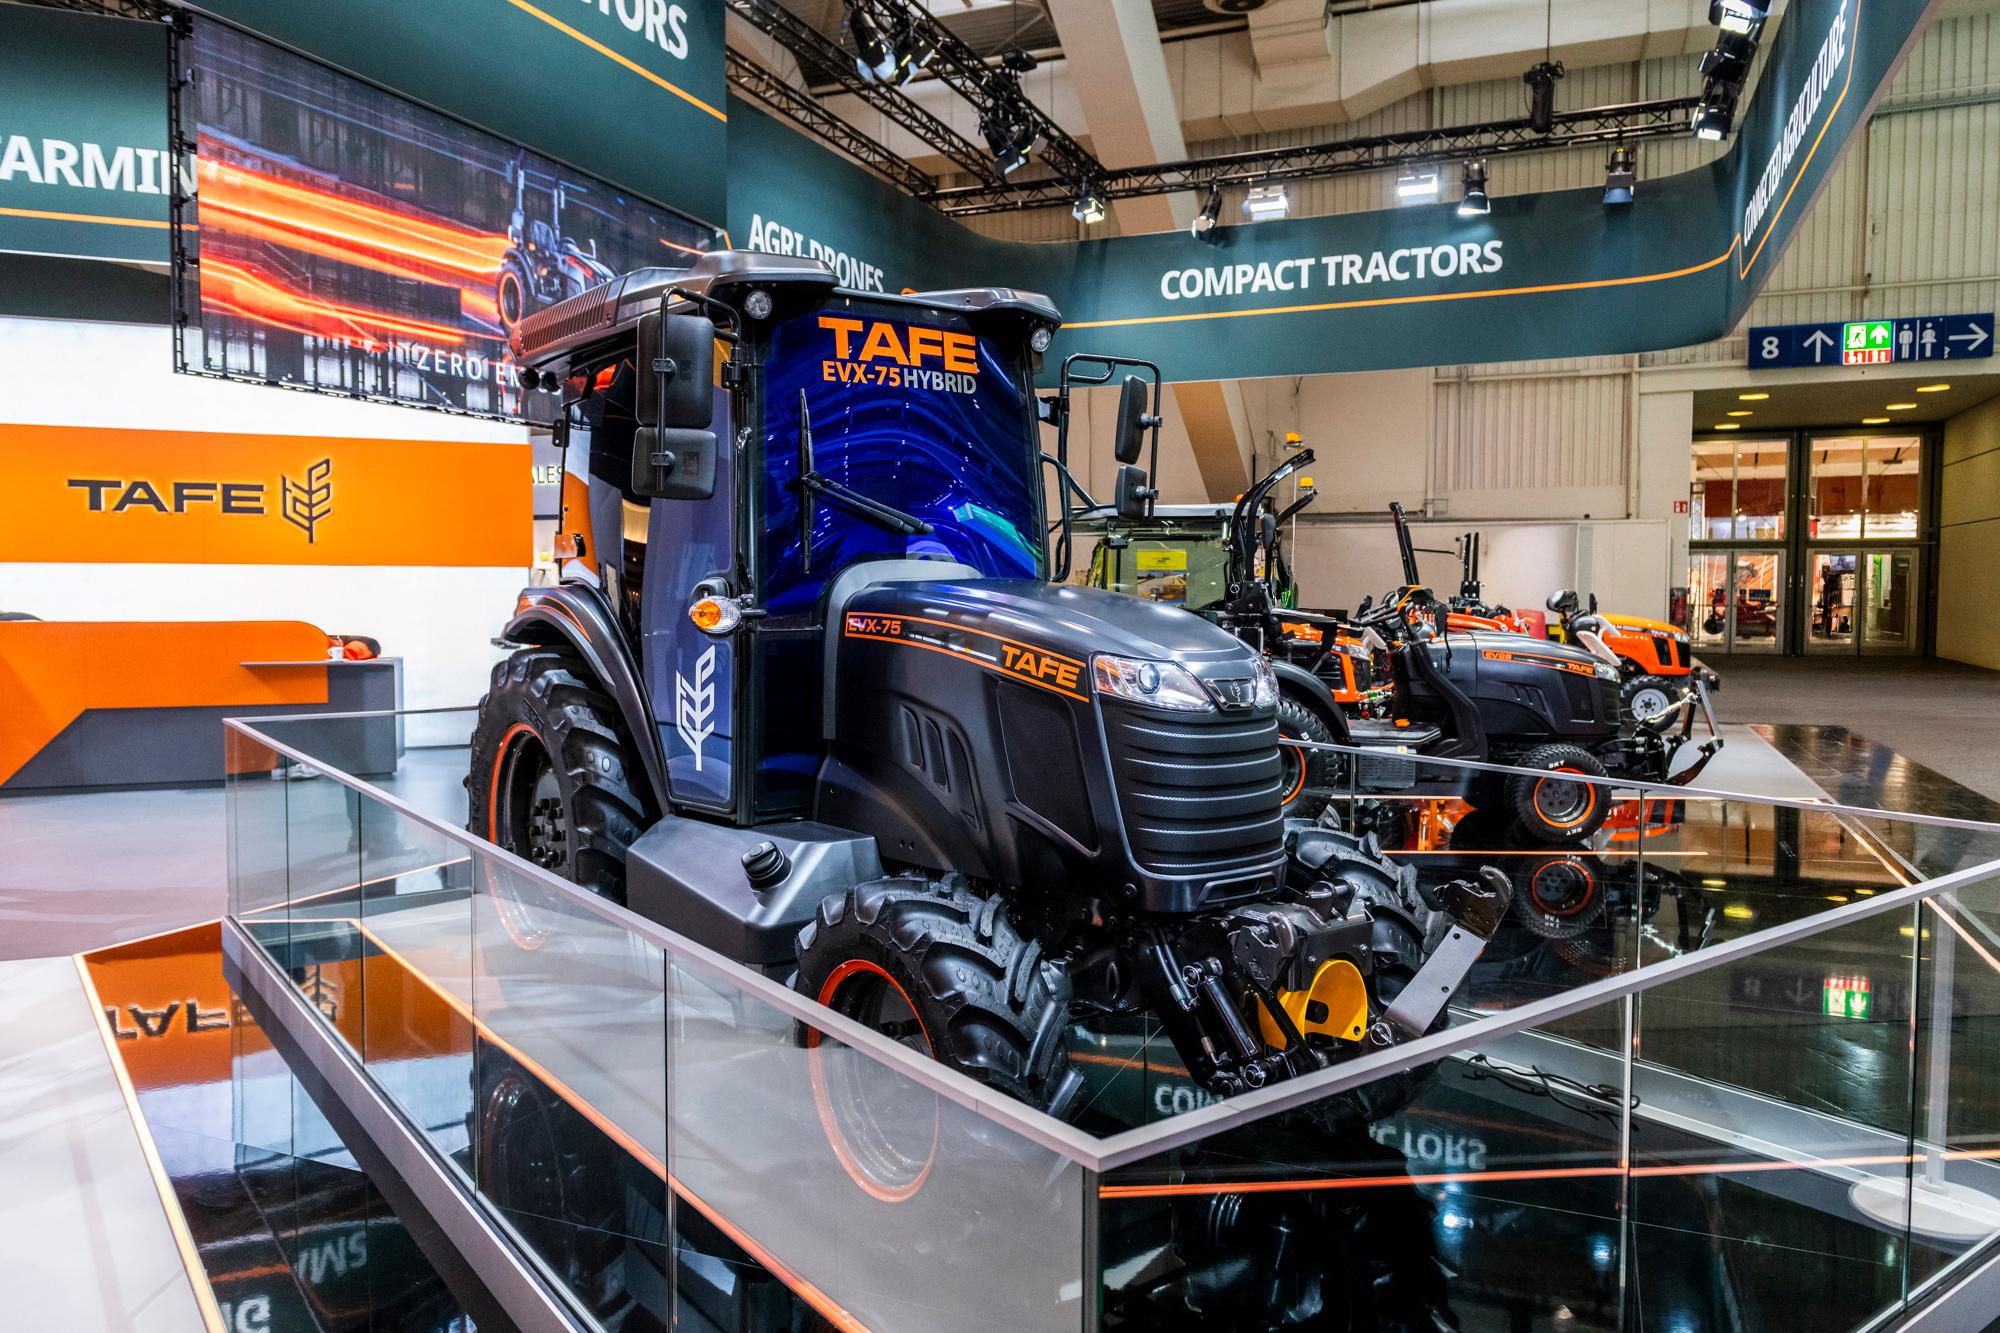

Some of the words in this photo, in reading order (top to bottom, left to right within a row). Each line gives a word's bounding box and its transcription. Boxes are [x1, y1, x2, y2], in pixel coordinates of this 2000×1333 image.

[582, 0, 688, 60] ORS
[1744, 141, 1781, 247] CONNECTED
[1781, 0, 1847, 178] AGRICULTURE
[0, 135, 198, 198] ARMIN
[1161, 258, 1316, 300] COMPACT
[1322, 240, 1503, 287] TRACTORS
[417, 346, 482, 380] ZERO
[818, 316, 978, 374] TAFE
[1761, 336, 1779, 360] 8
[822, 360, 901, 387] EVX-75
[903, 368, 977, 395] HYBRID
[67, 479, 265, 514] TAFE
[847, 617, 902, 636] EVX-75
[1002, 644, 1081, 690] TAFE
[1567, 662, 1594, 675] TAFE
